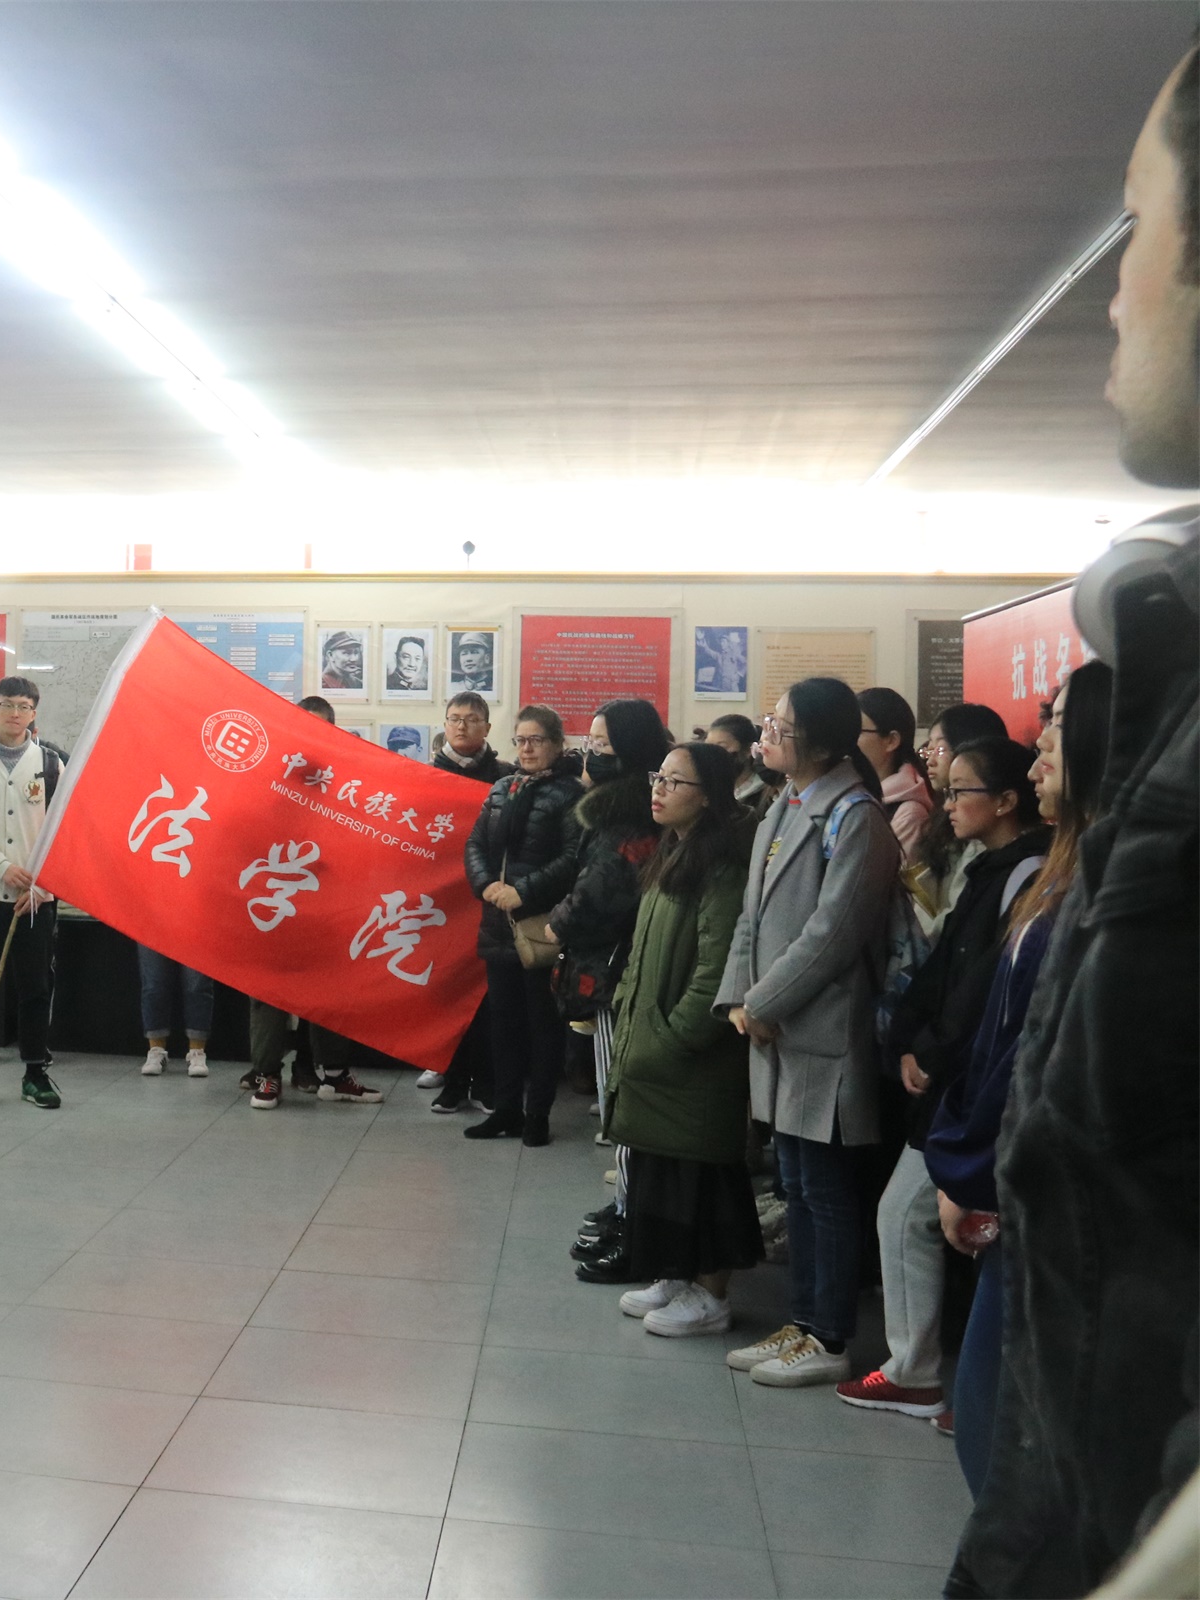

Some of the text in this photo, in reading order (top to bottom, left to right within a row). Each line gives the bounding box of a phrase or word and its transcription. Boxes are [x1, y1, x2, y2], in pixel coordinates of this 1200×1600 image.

[220, 713, 262, 733] UNIVERSITY
[250, 744, 266, 763] CHINA
[270, 780, 436, 861] MINZU UNIVERSITY OF CHINA
[127, 773, 447, 986] 法学院
